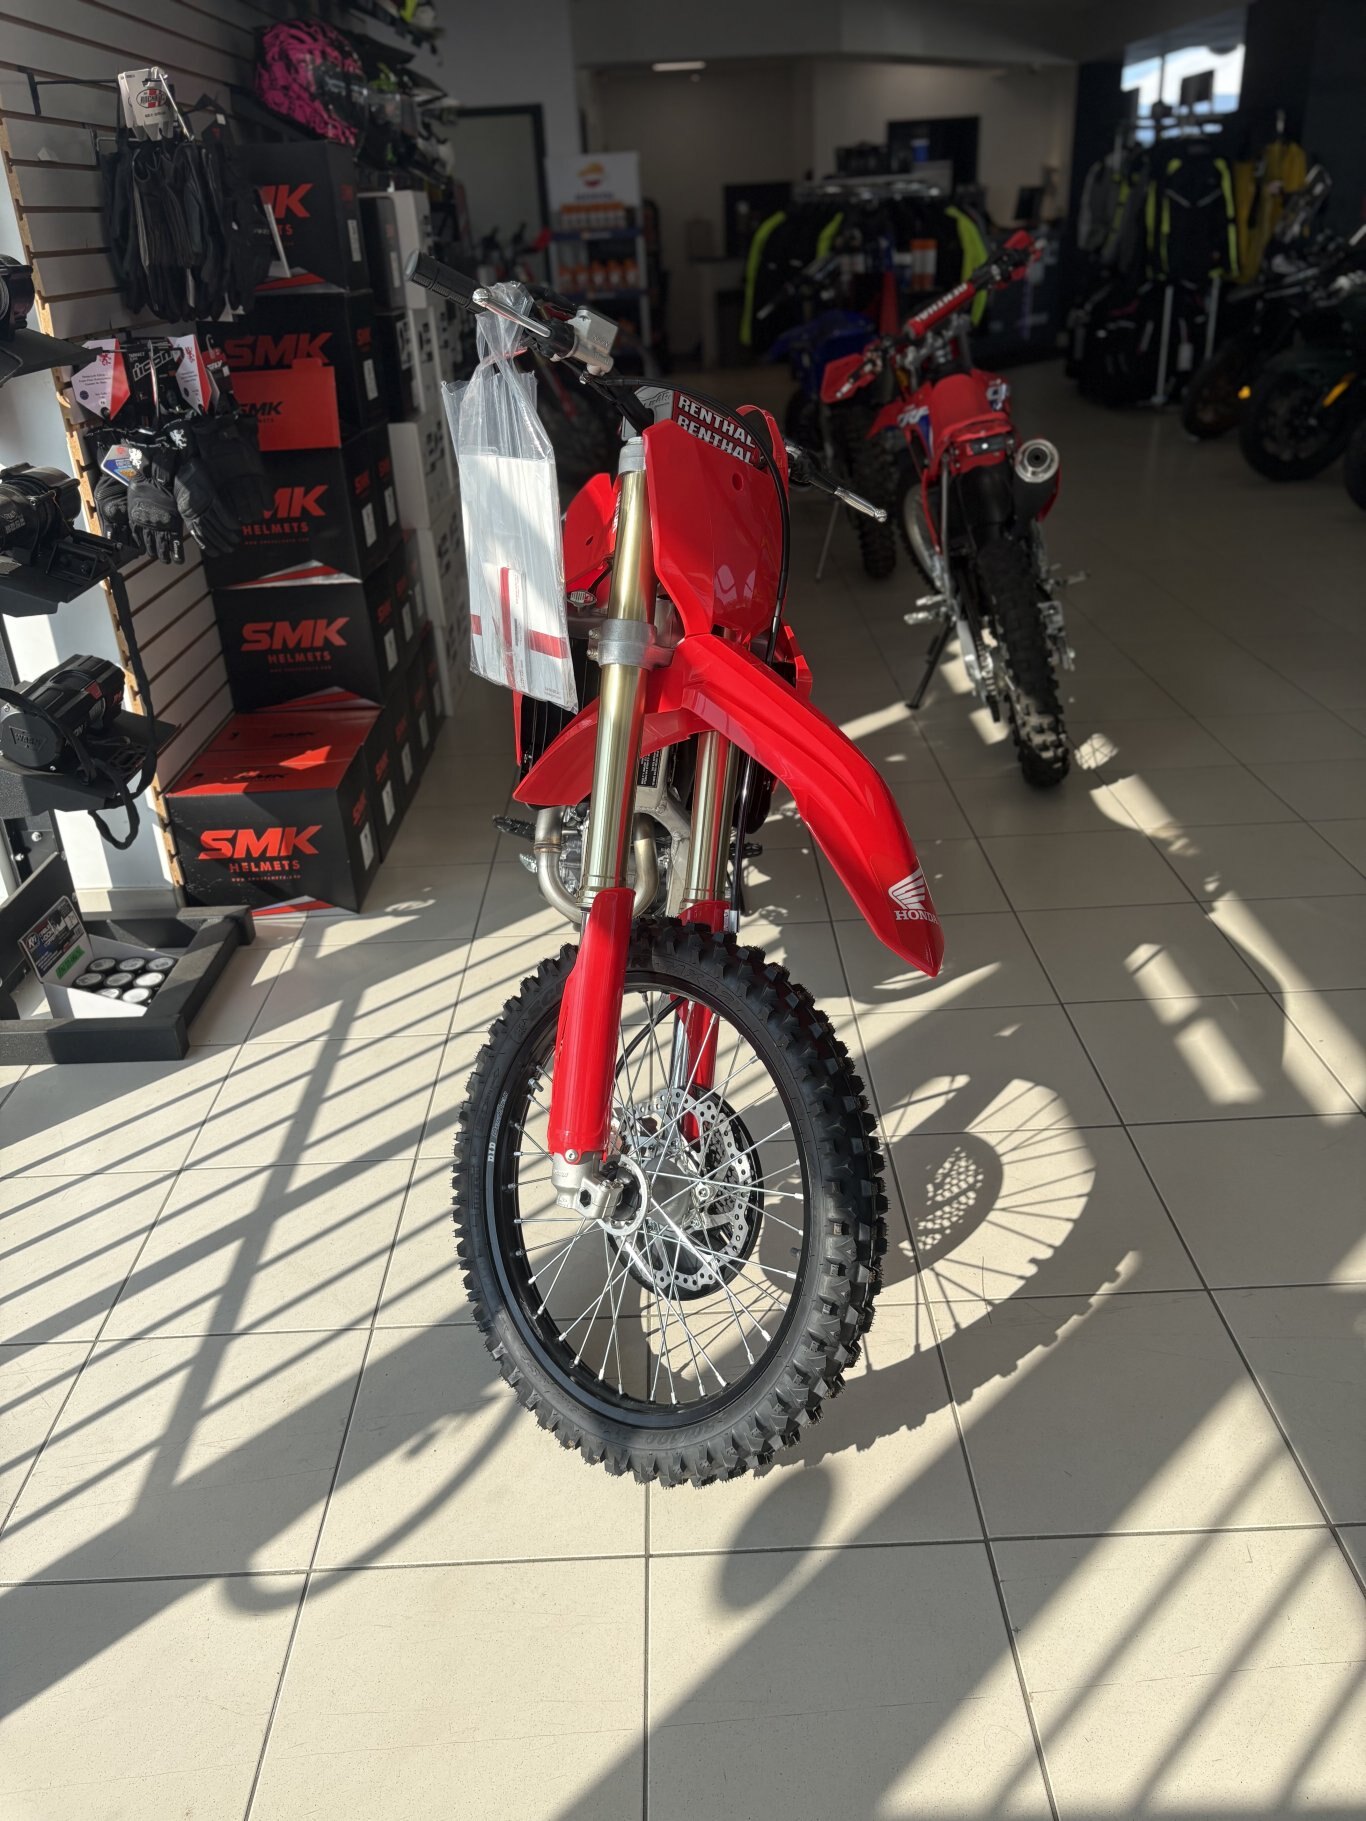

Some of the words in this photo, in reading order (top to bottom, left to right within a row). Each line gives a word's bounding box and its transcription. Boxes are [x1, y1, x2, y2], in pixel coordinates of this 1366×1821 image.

[223, 331, 333, 367] SMK
[677, 395, 756, 448] RENTHAL
[241, 521, 310, 536] HELMETS
[240, 616, 350, 651] SMK
[268, 651, 332, 664] HELMETS
[198, 824, 323, 860] SMK
[229, 860, 301, 873] HELMETS
[894, 909, 939, 925] HONDA
